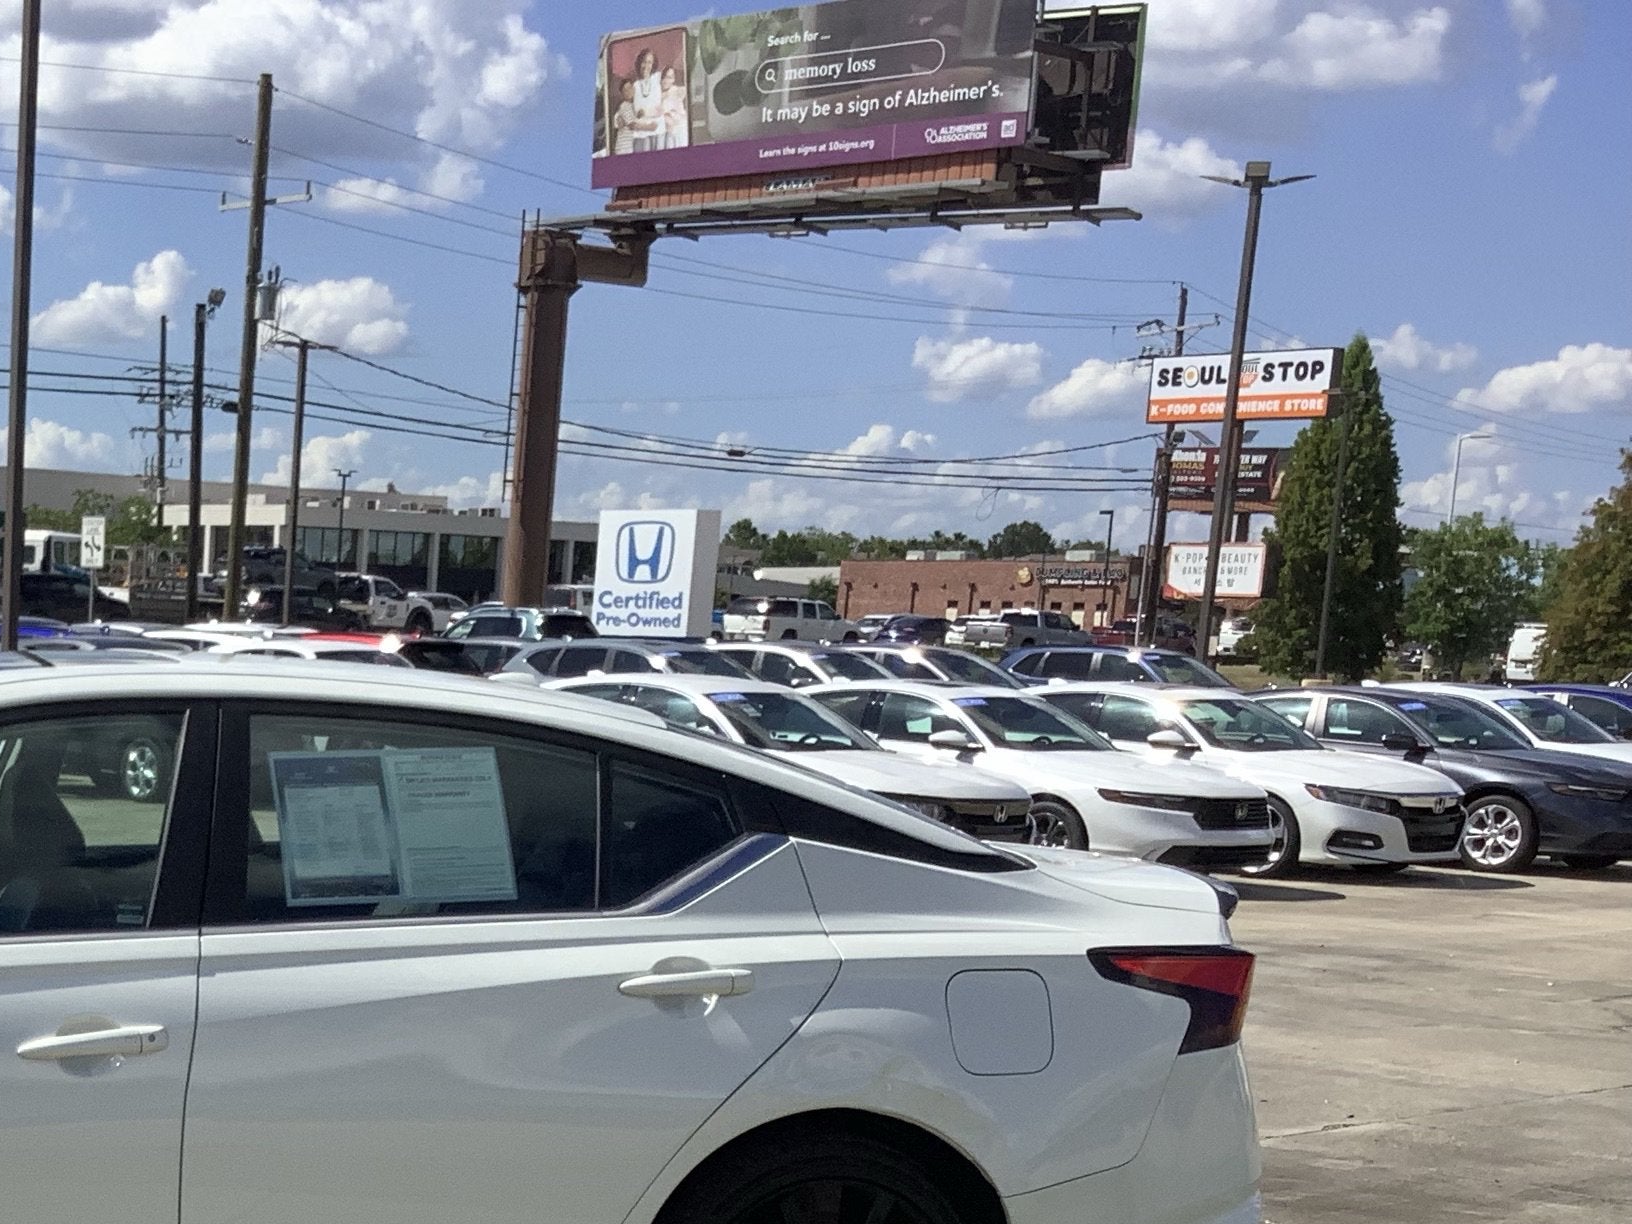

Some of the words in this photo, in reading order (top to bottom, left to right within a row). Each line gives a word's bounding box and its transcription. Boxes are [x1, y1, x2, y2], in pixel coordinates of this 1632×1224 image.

[767, 31, 801, 47] Search
[803, 30, 819, 42] for
[784, 62, 844, 79] memory
[847, 57, 876, 73] loss
[762, 107, 773, 123] It
[777, 105, 808, 124] may
[812, 100, 831, 117] be
[834, 102, 843, 115] a
[848, 95, 879, 117] sign
[884, 90, 902, 108] of
[1157, 364, 1227, 388] SEOUL
[1261, 360, 1325, 382] STOP
[1150, 403, 1197, 417] K-FOOD
[1284, 398, 1324, 411] STORE
[1221, 553, 1259, 563] BEAUTY
[1227, 566, 1248, 576] MORE
[598, 590, 683, 610] Certified
[596, 612, 682, 628] Pre-Owned
